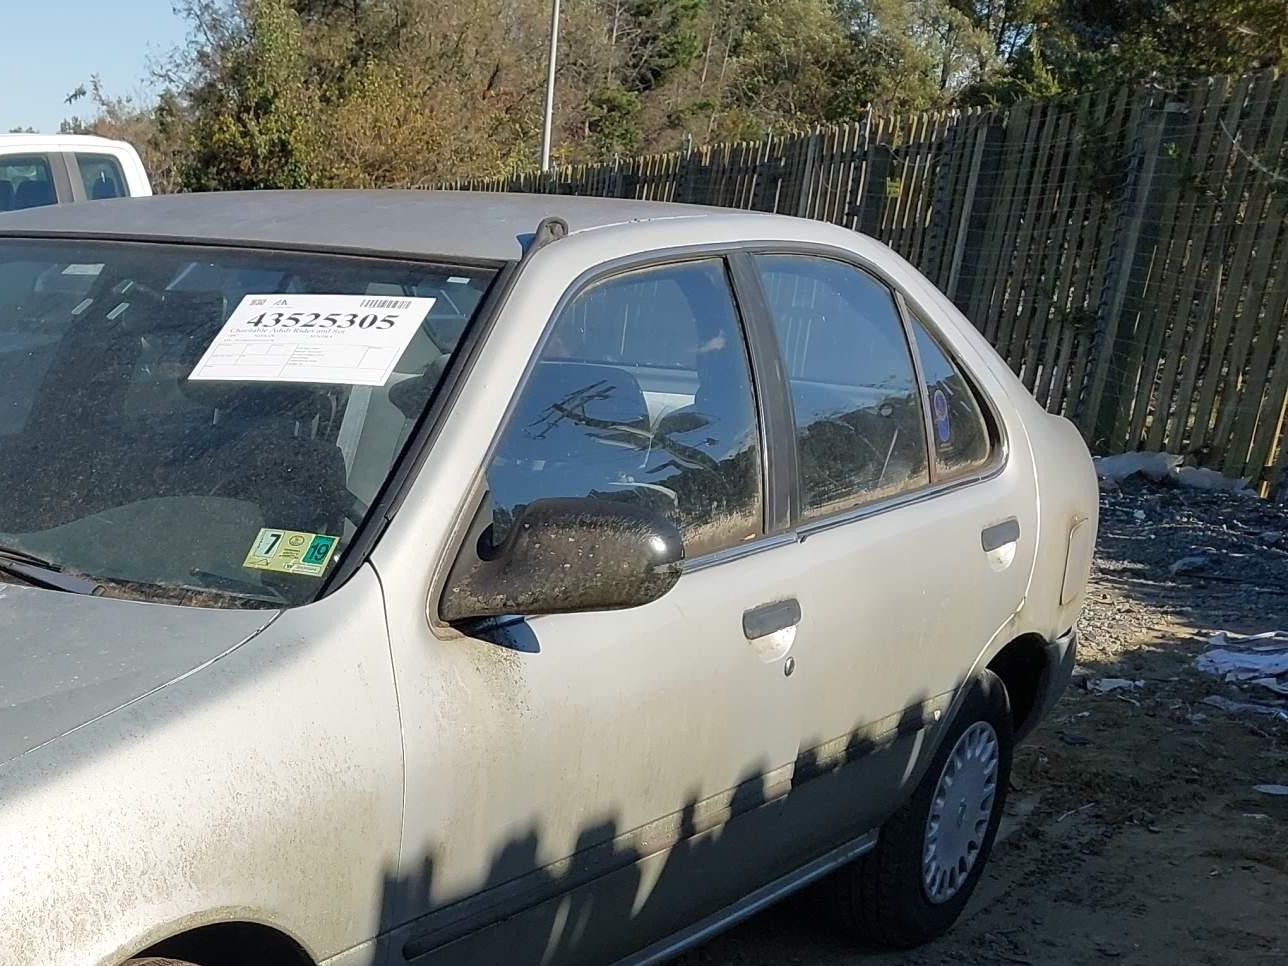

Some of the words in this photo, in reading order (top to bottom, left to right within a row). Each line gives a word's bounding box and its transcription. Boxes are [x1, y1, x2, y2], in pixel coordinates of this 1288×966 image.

[247, 312, 399, 329] 43525305
[264, 534, 281, 554] 7
[309, 543, 329, 561] 19
